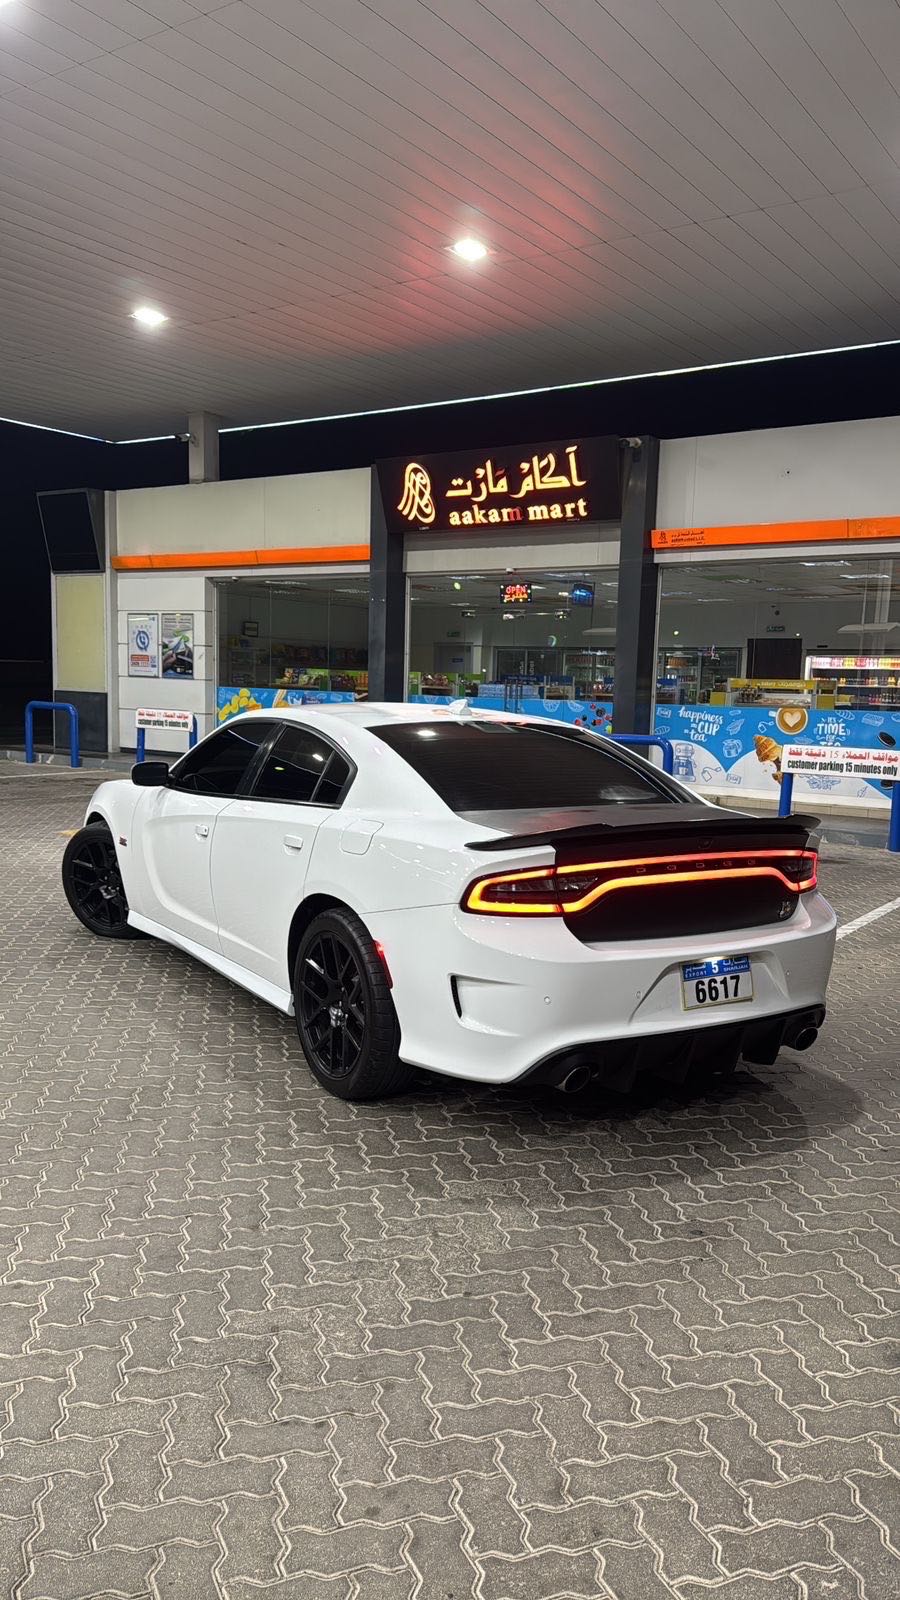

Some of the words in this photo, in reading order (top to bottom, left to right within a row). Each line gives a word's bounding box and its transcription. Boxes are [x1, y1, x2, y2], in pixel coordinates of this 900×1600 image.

[449, 504, 522, 526] aakam
[527, 498, 588, 521] mart
[505, 585, 527, 594] OPEN
[678, 706, 723, 724] happiness
[697, 721, 720, 736] CUP
[816, 723, 846, 736] TIME
[689, 729, 708, 742] tea
[788, 747, 803, 756] فقط
[804, 748, 826, 759] دقيقة
[829, 750, 839, 759] 15
[842, 750, 870, 760] العملاء
[872, 752, 899, 764] مواقف
[787, 759, 819, 770] customer
[819, 761, 844, 773] parking
[845, 762, 853, 772] 15
[853, 763, 881, 775] minutes
[882, 765, 898, 776] only
[711, 959, 719, 974] 5
[685, 970, 707, 979] EXPORT
[695, 974, 740, 1004] 6617
